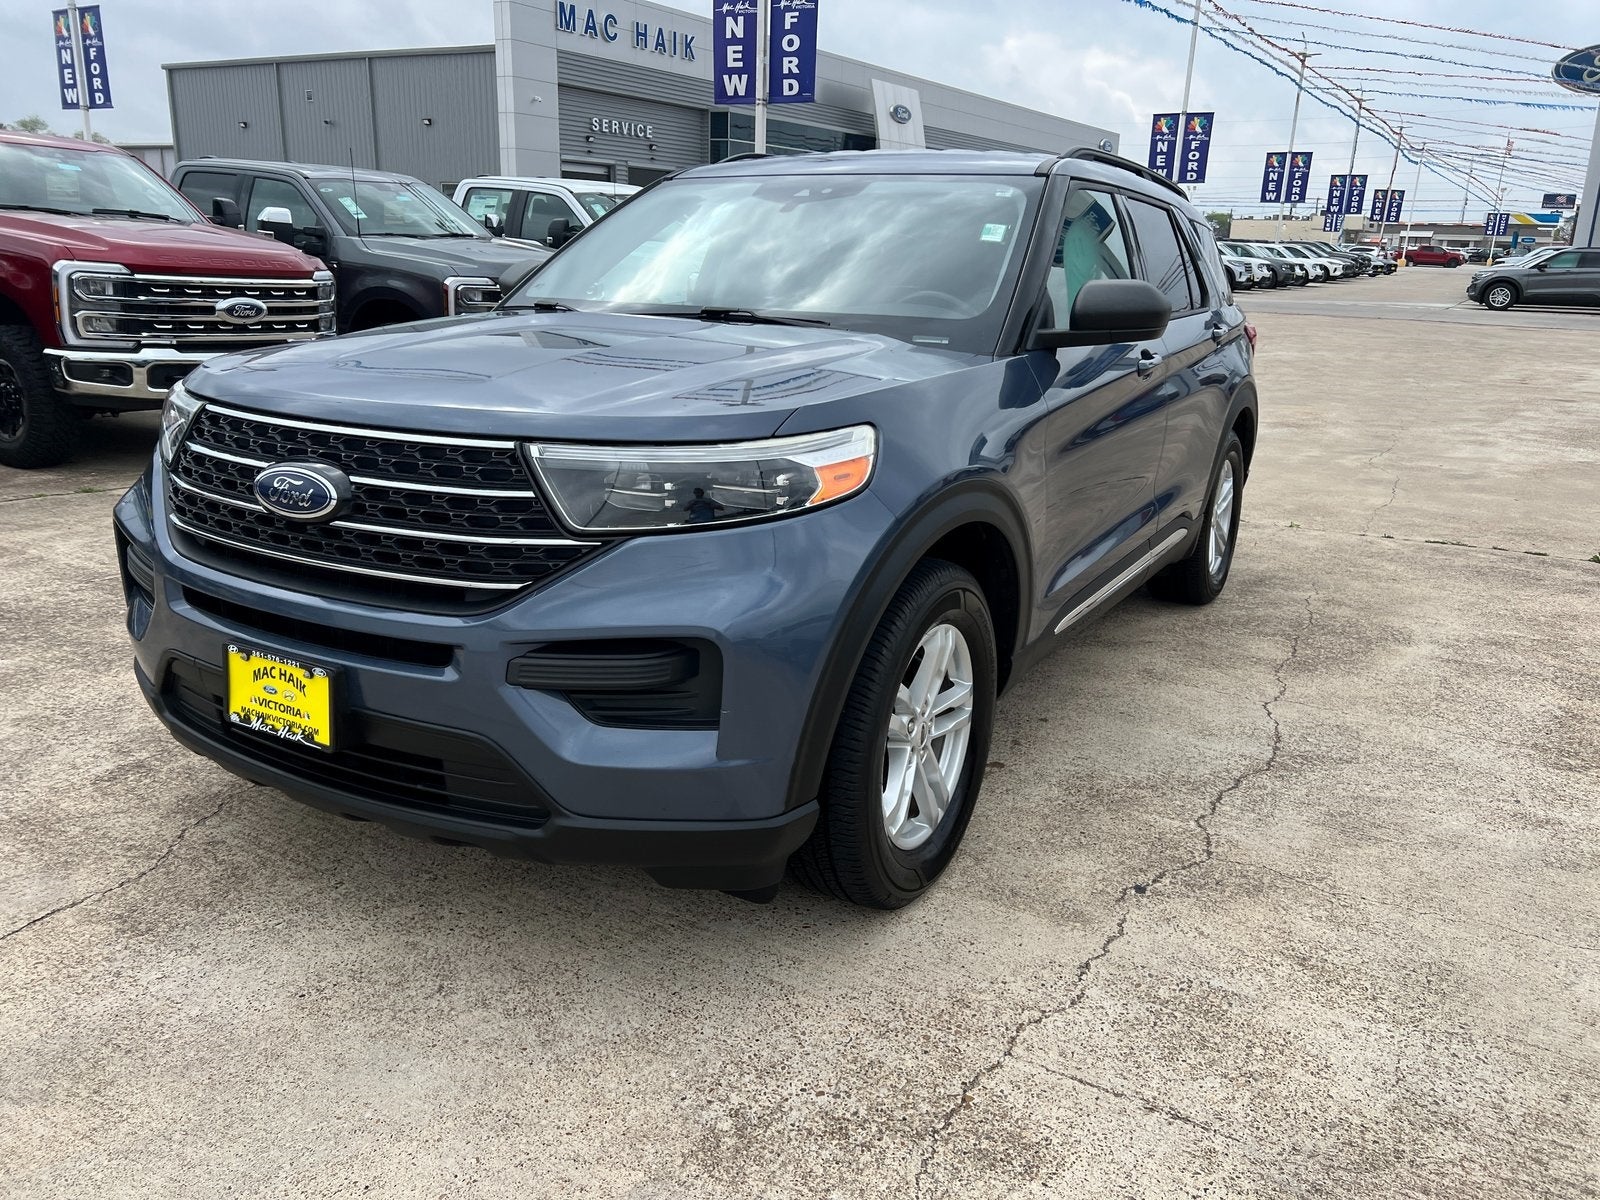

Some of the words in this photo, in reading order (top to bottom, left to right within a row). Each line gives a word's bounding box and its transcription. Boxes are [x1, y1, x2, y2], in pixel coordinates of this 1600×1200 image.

[557, 1, 619, 42] MAC
[633, 20, 696, 61] HAIK
[723, 15, 748, 97] NEW
[782, 11, 800, 96] FORD
[61, 48, 78, 104] NEW
[89, 47, 105, 105] FORD
[592, 117, 653, 138] SERVICE
[1186, 141, 1201, 181] FORD
[1265, 172, 1278, 201] NEW
[1291, 172, 1303, 201] FORD
[1330, 190, 1340, 213] NEW
[1350, 190, 1360, 213] FORD
[1373, 203, 1382, 221] NEW
[1389, 203, 1398, 221] FORD
[232, 304, 257, 317] Ford
[268, 476, 314, 507] Ford
[252, 666, 276, 683] MAC
[279, 668, 307, 697] HAIK
[257, 696, 303, 719] VICTORIA
[249, 716, 277, 735] Mac
